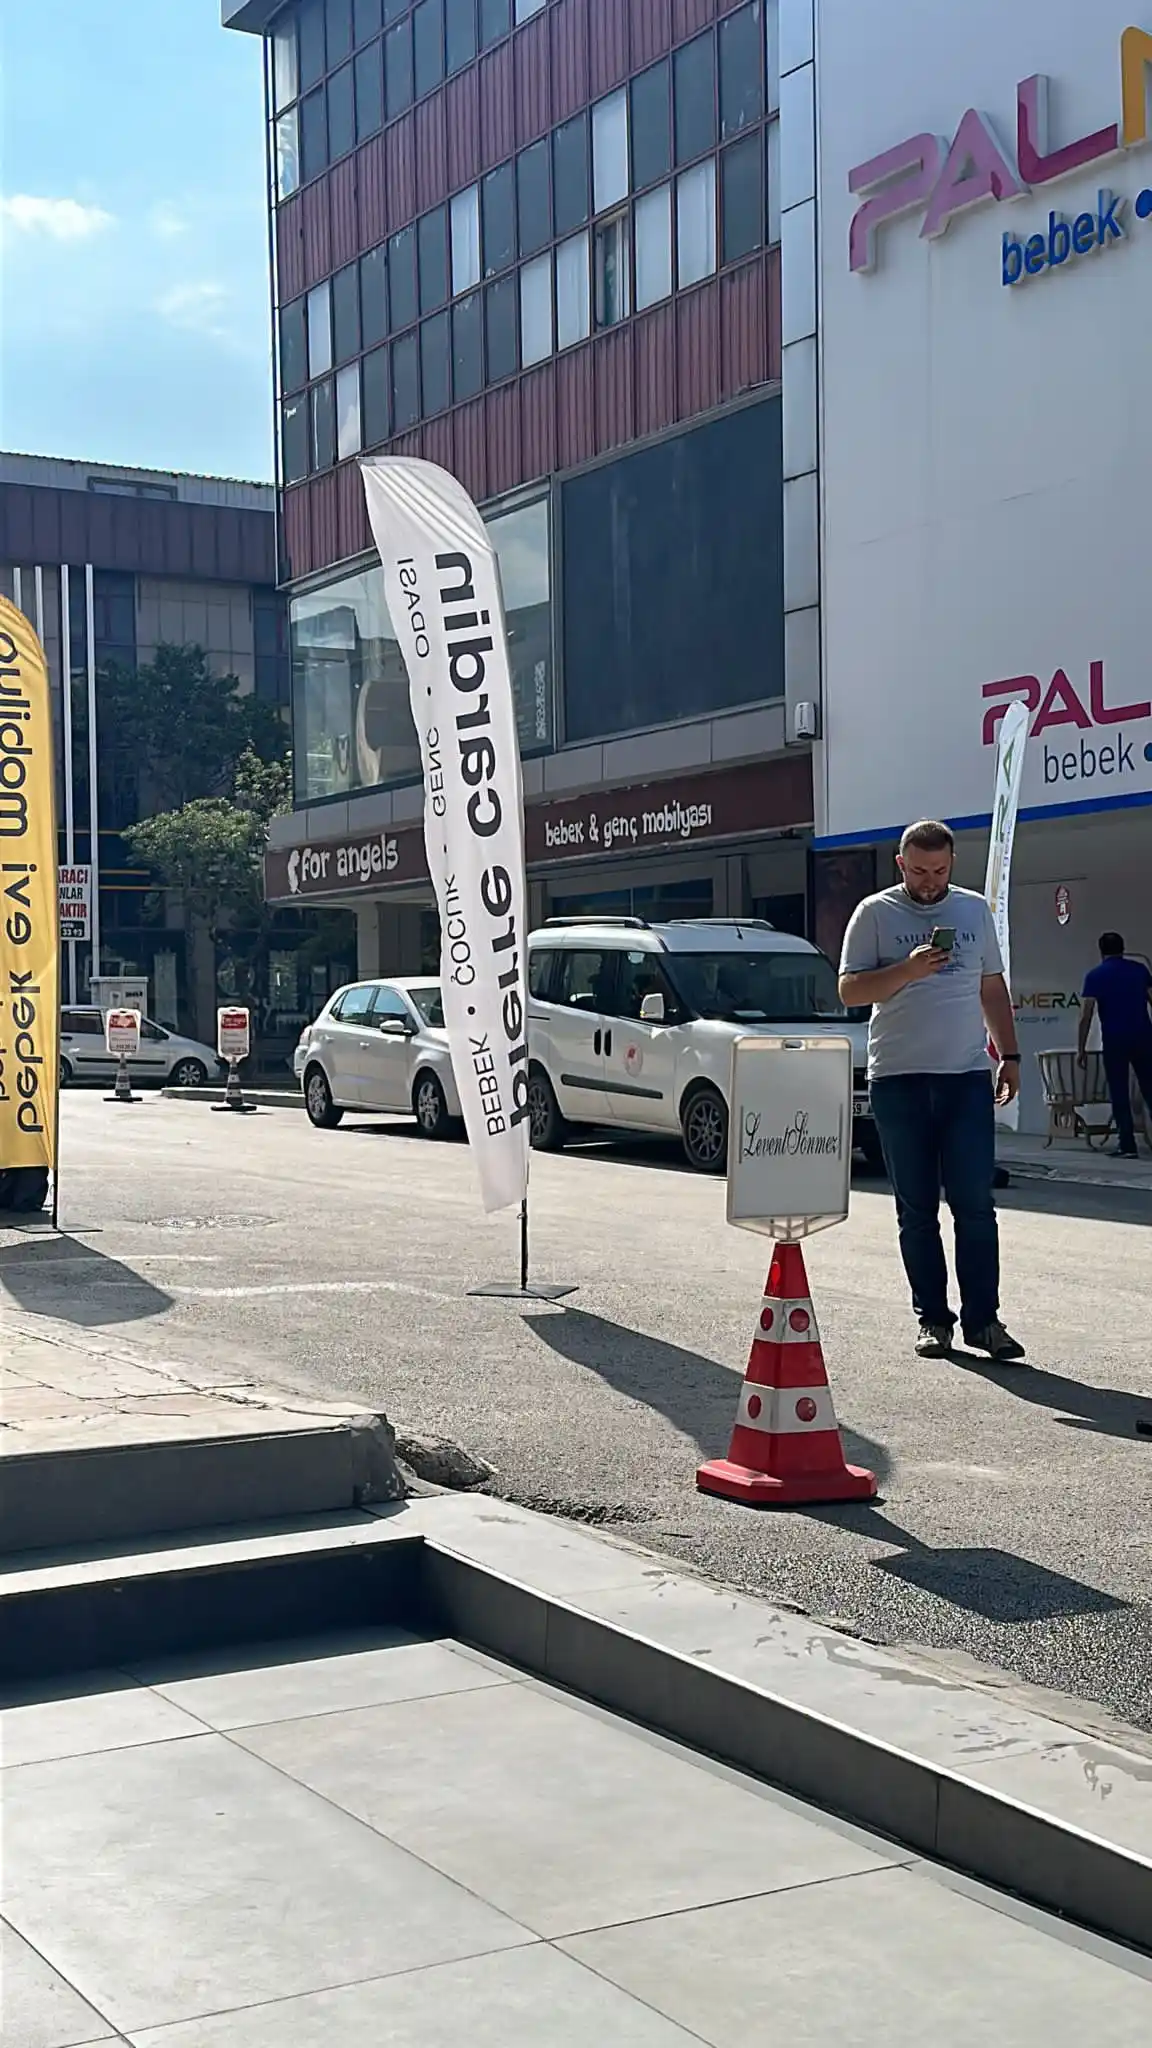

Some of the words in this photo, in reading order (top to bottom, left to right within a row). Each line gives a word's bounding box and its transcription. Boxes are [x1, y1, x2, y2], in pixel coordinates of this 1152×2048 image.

[1002, 188, 1127, 286] bebek
[1044, 732, 1135, 784] bebek
[589, 813, 599, 843] &
[603, 816, 638, 848] genç
[642, 800, 712, 837] mobilyası
[302, 848, 331, 882] for
[337, 833, 399, 882] angels
